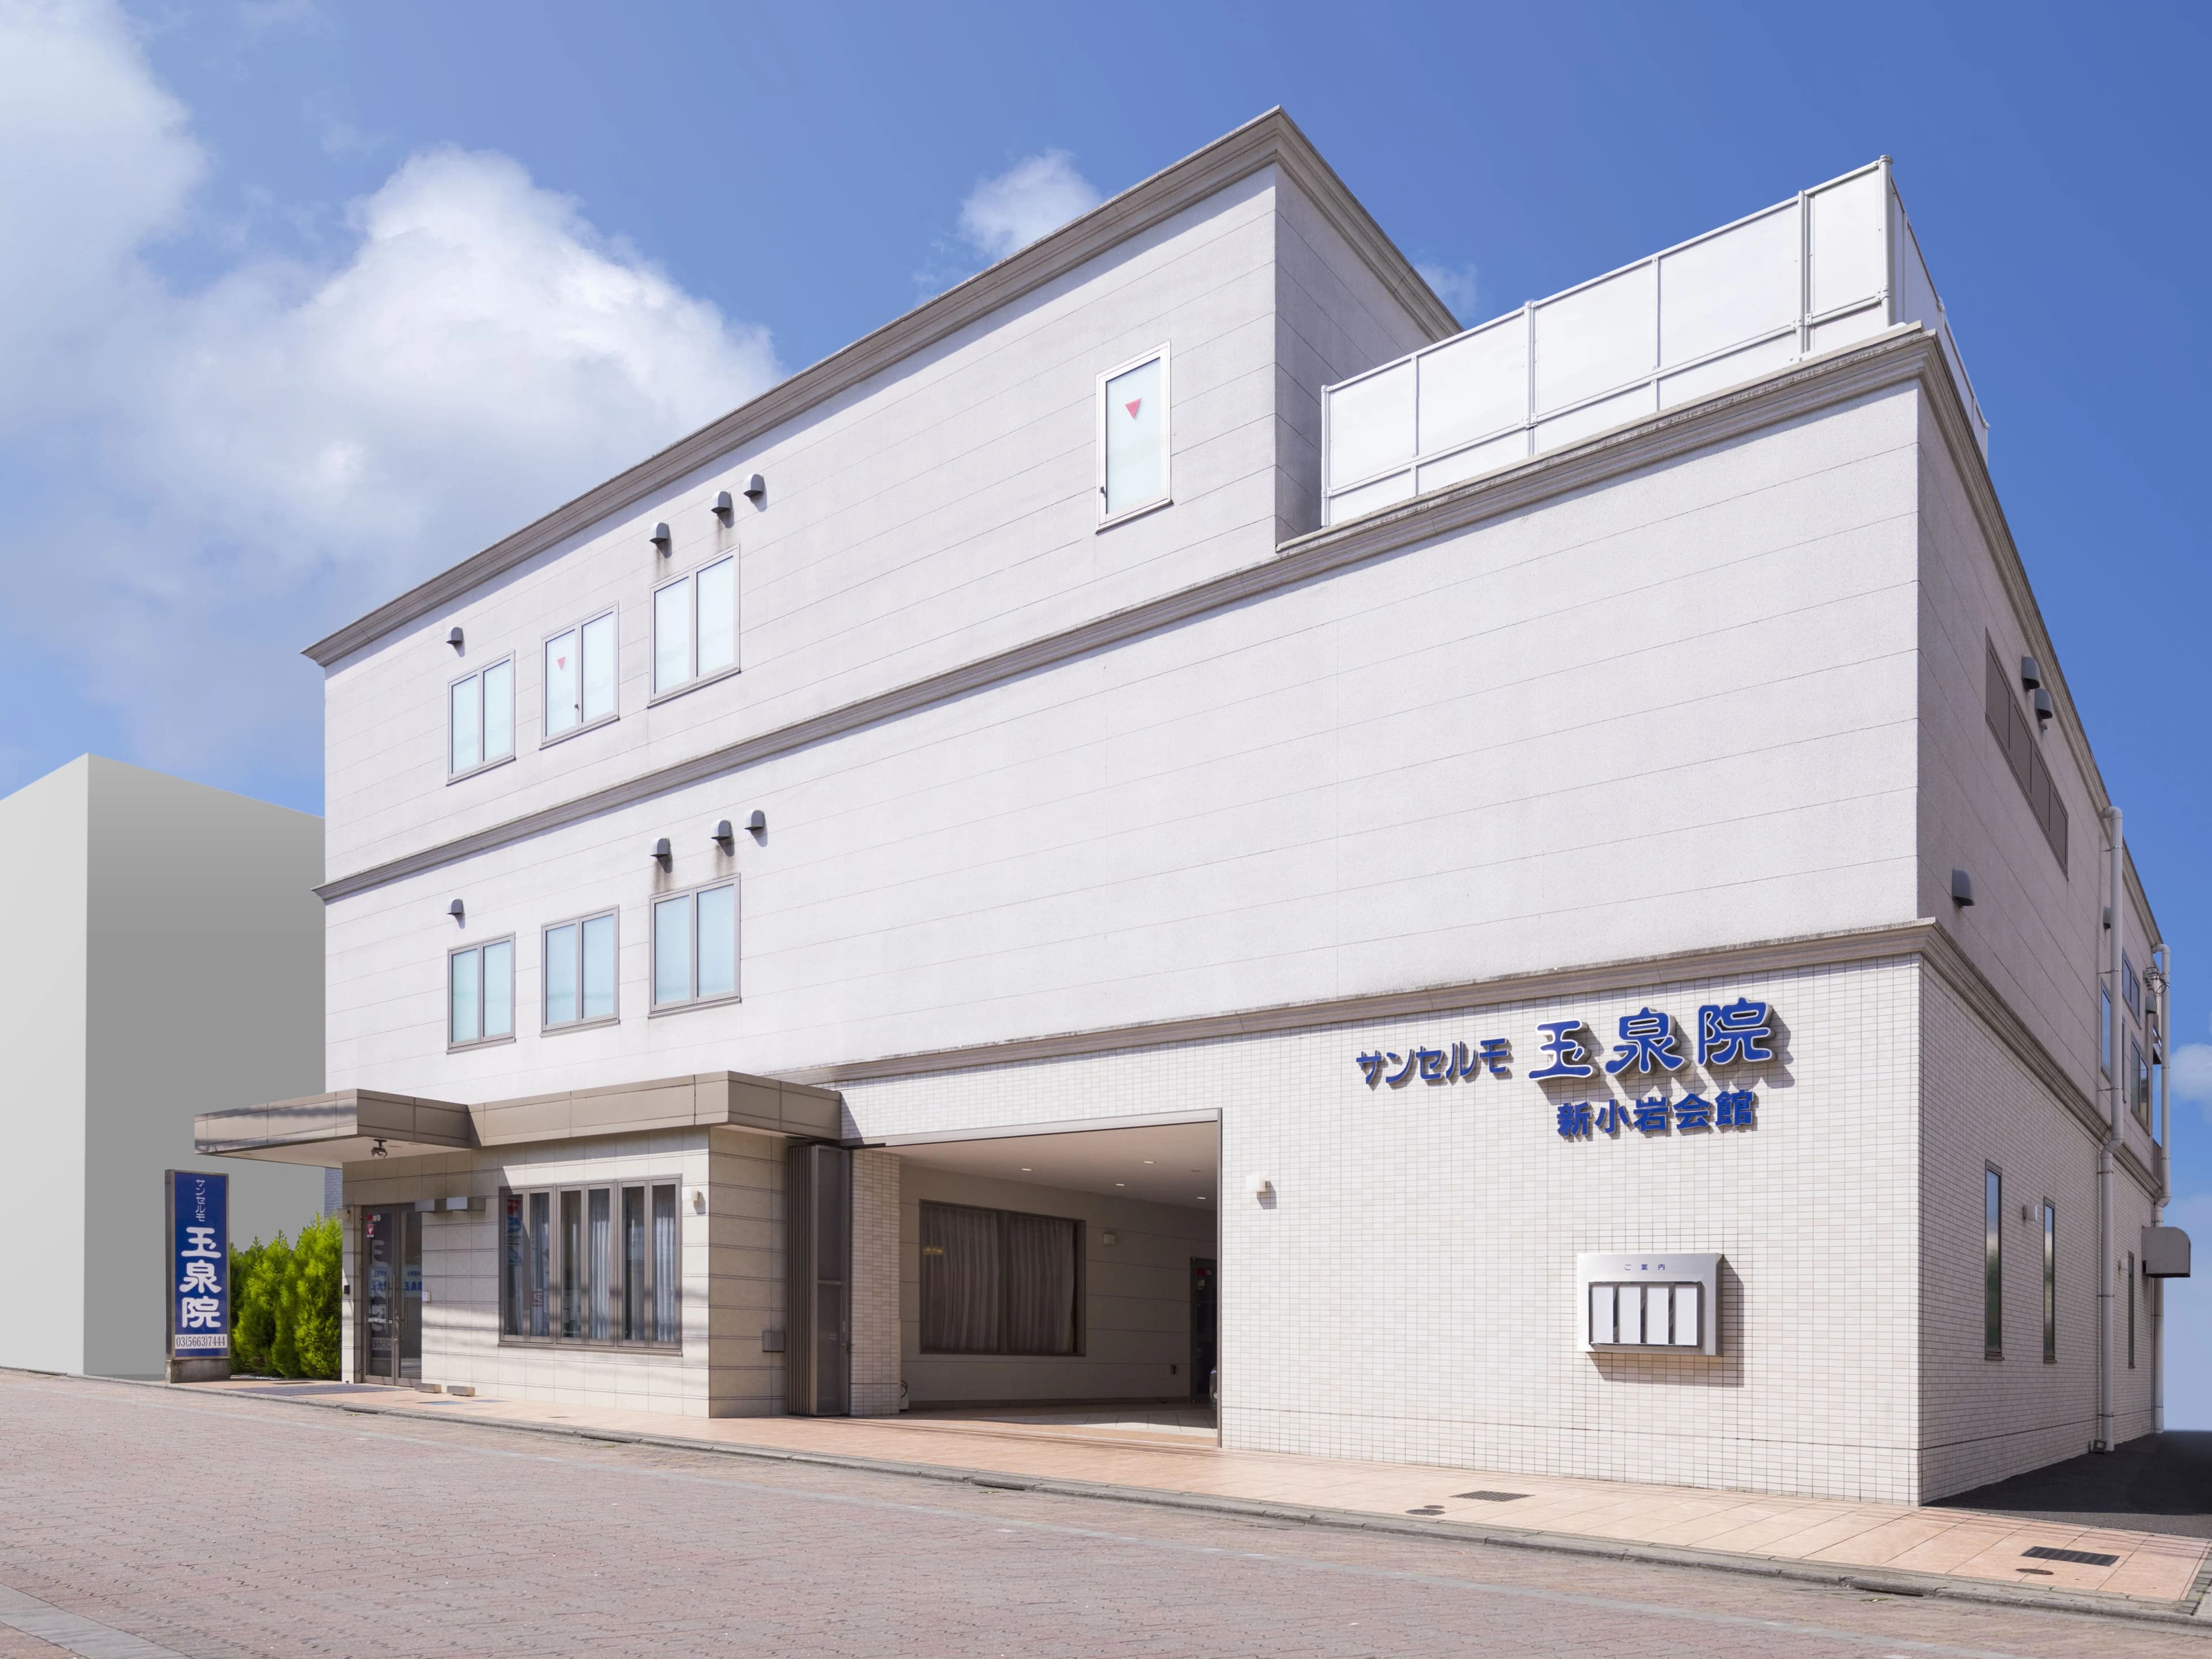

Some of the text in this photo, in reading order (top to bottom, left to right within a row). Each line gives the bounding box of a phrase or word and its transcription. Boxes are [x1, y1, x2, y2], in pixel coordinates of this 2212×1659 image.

[1355, 997, 1774, 1084] サンセルモ 玉泉院
[1556, 1089, 1754, 1138] 新小岩会館
[195, 1179, 206, 1222] サンセルモ
[179, 1226, 222, 1328] 玉泉院
[176, 1336, 225, 1348] 03(5663)7444
